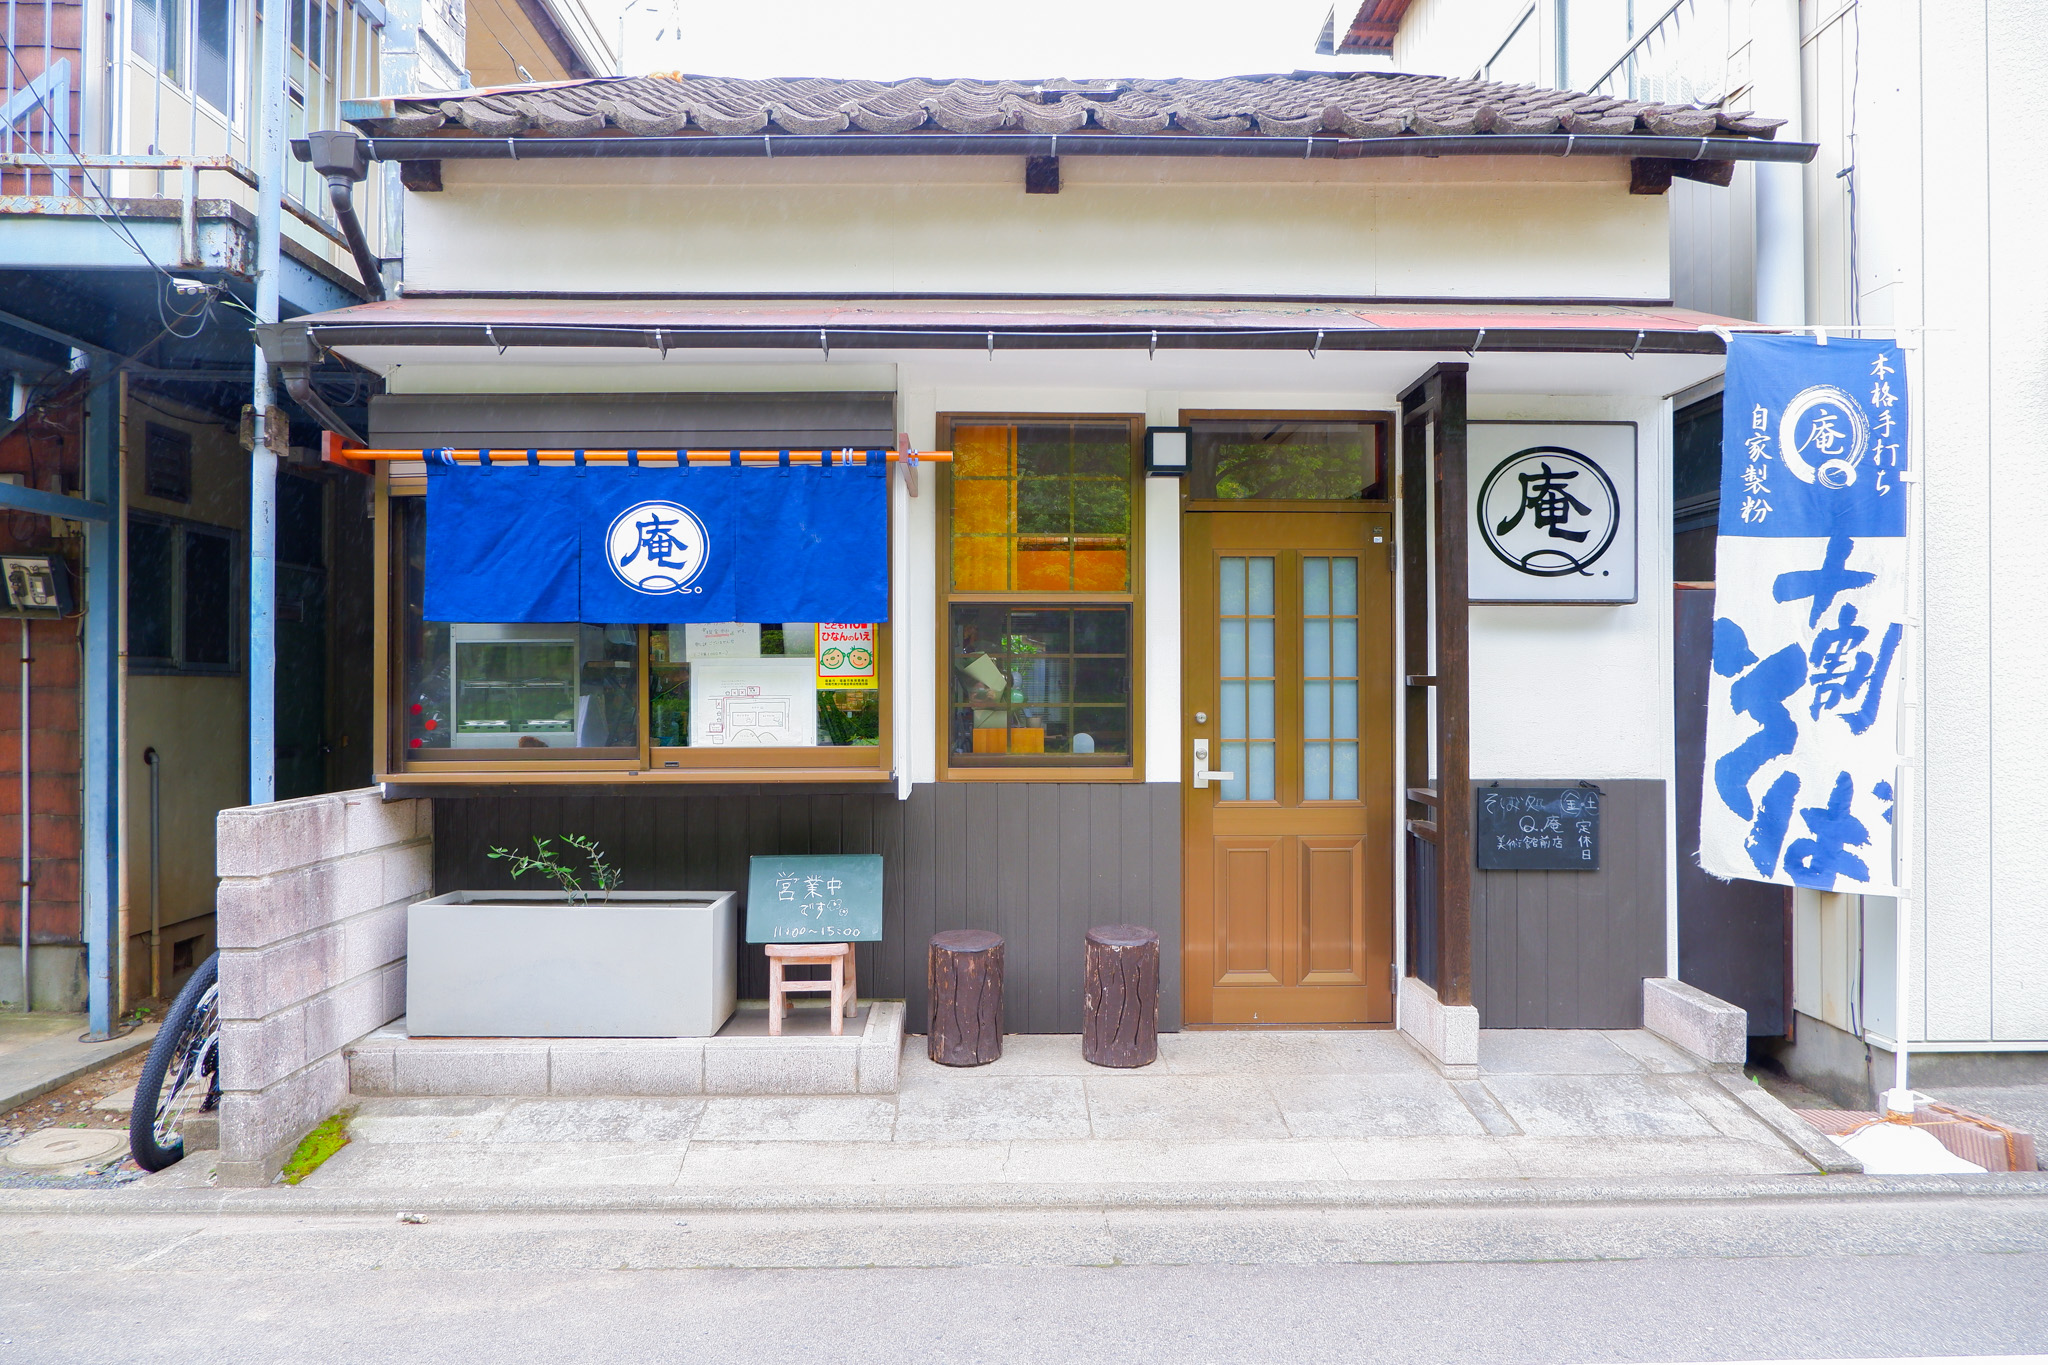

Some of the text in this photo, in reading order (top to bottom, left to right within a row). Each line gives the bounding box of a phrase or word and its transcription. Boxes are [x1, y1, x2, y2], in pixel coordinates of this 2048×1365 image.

[1798, 408, 1847, 455] 庵
[1869, 353, 1900, 497] 本格手打ち
[1740, 403, 1773, 524] 自家製粉
[1496, 461, 1593, 544] 庵
[620, 512, 689, 571] 庵
[821, 631, 871, 642] ひなんのいえ
[1773, 533, 1904, 736] 十割
[1712, 618, 1894, 890] そば
[1496, 834, 1563, 851] 美術館前店
[1576, 820, 1593, 860] 定休日
[775, 871, 843, 901] 営業中
[800, 902, 825, 919] です
